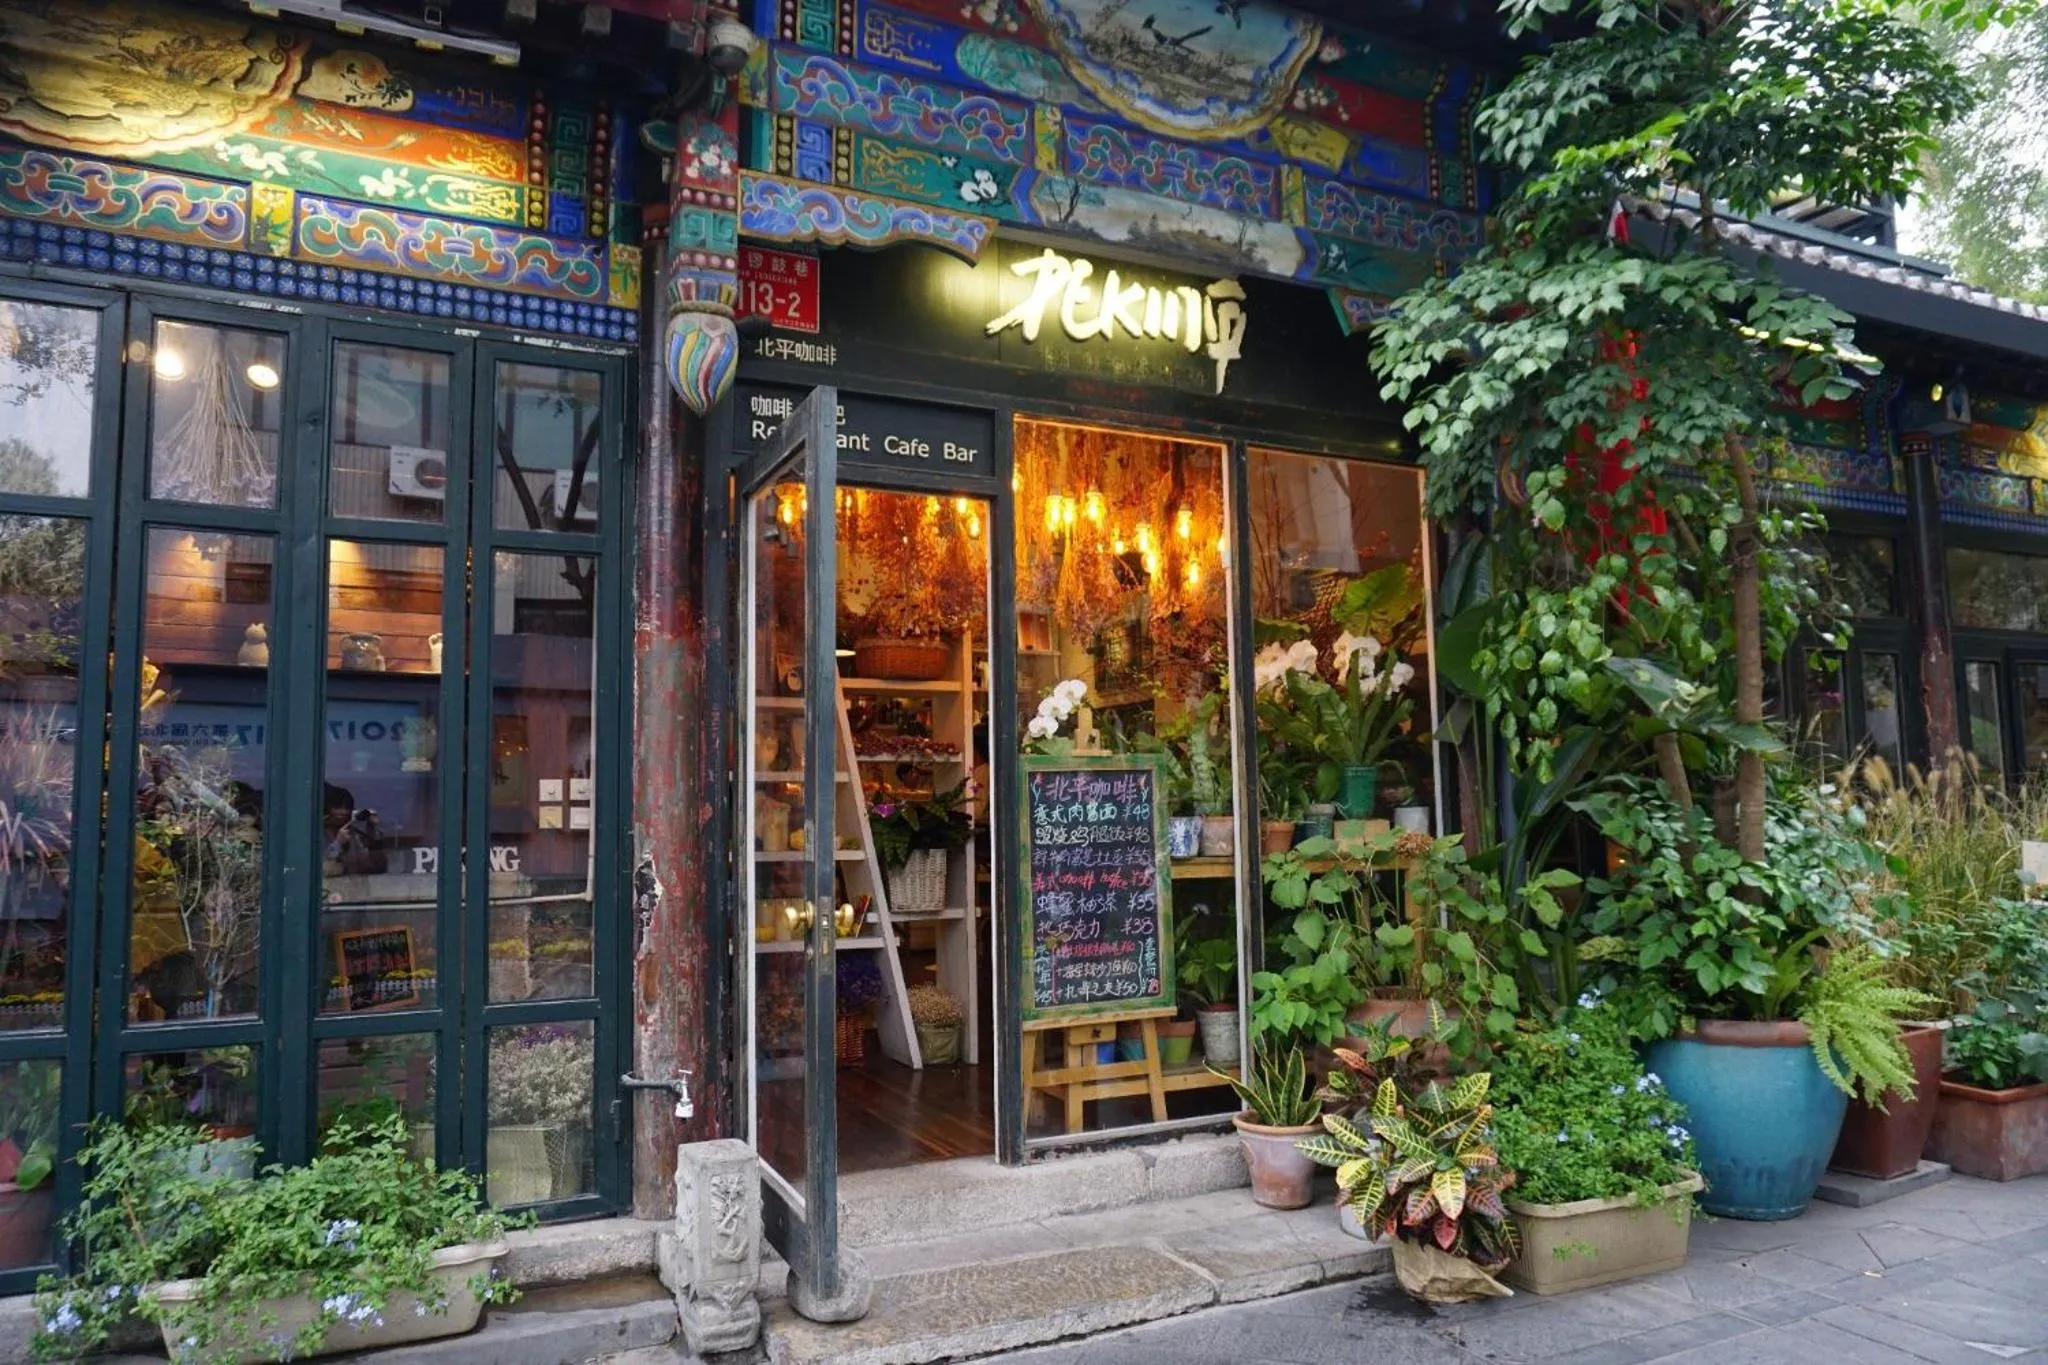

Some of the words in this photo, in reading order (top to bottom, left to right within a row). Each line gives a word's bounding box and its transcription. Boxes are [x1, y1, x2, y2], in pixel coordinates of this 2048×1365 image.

[754, 337, 837, 366] 北平咖啡
[884, 436, 930, 458] Cafe
[943, 443, 978, 463] Bar
[1045, 772, 1138, 803] 北平咖啡
